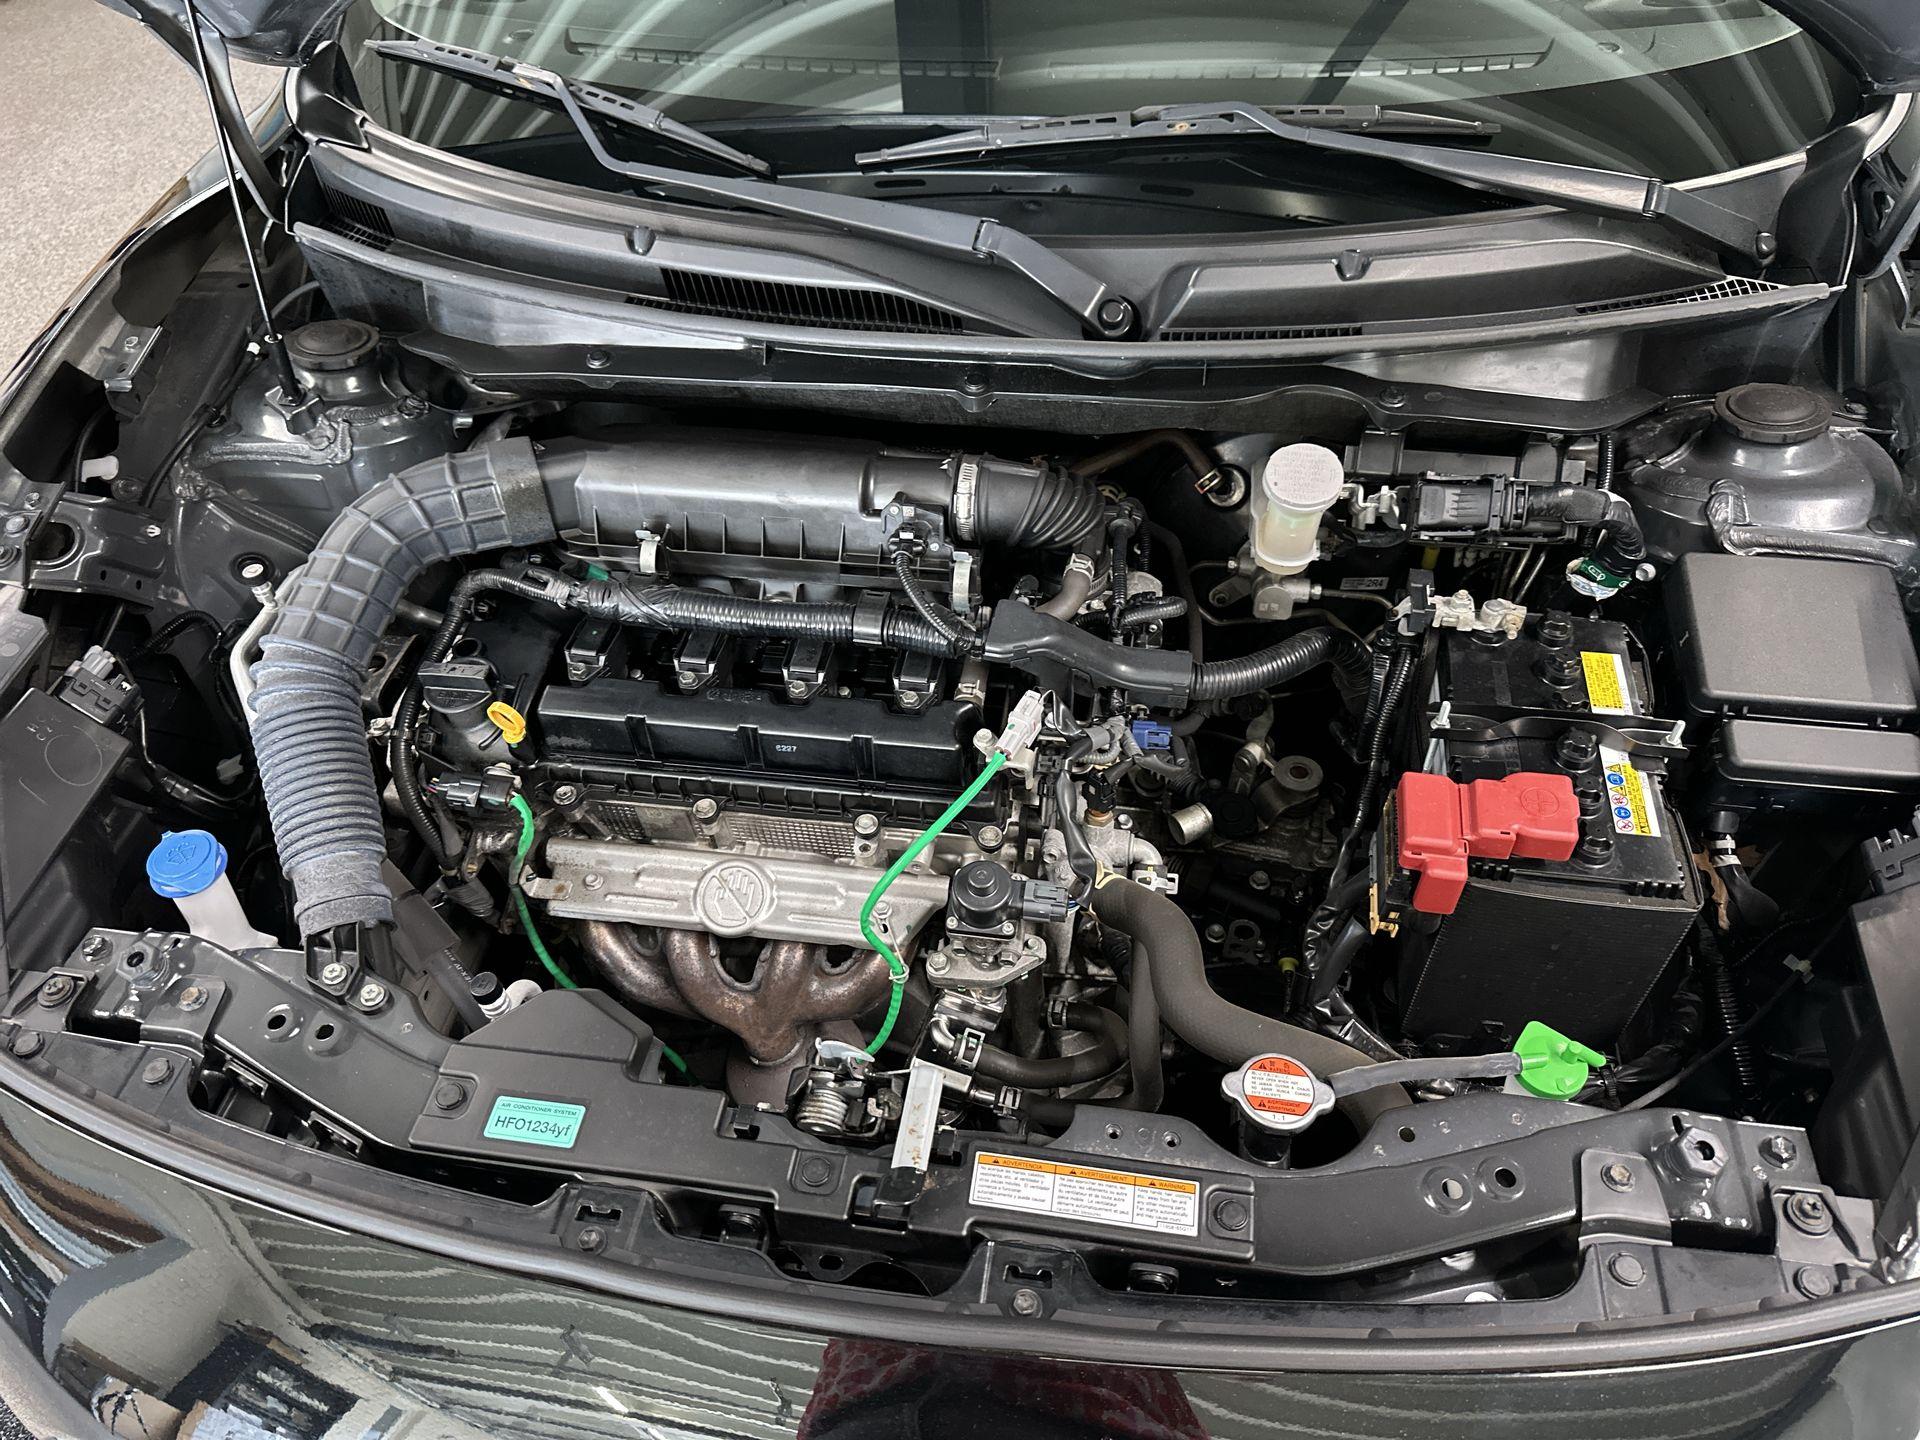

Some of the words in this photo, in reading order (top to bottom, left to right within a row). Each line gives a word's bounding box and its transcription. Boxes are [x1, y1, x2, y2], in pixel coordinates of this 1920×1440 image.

[513, 1104, 551, 1112] CONDITIONER
[495, 1116, 572, 1138] HFO1234yf
[1003, 1160, 1042, 1169] ADVERTENCIA
[1080, 1171, 1128, 1181] AVERTISSEMENT
